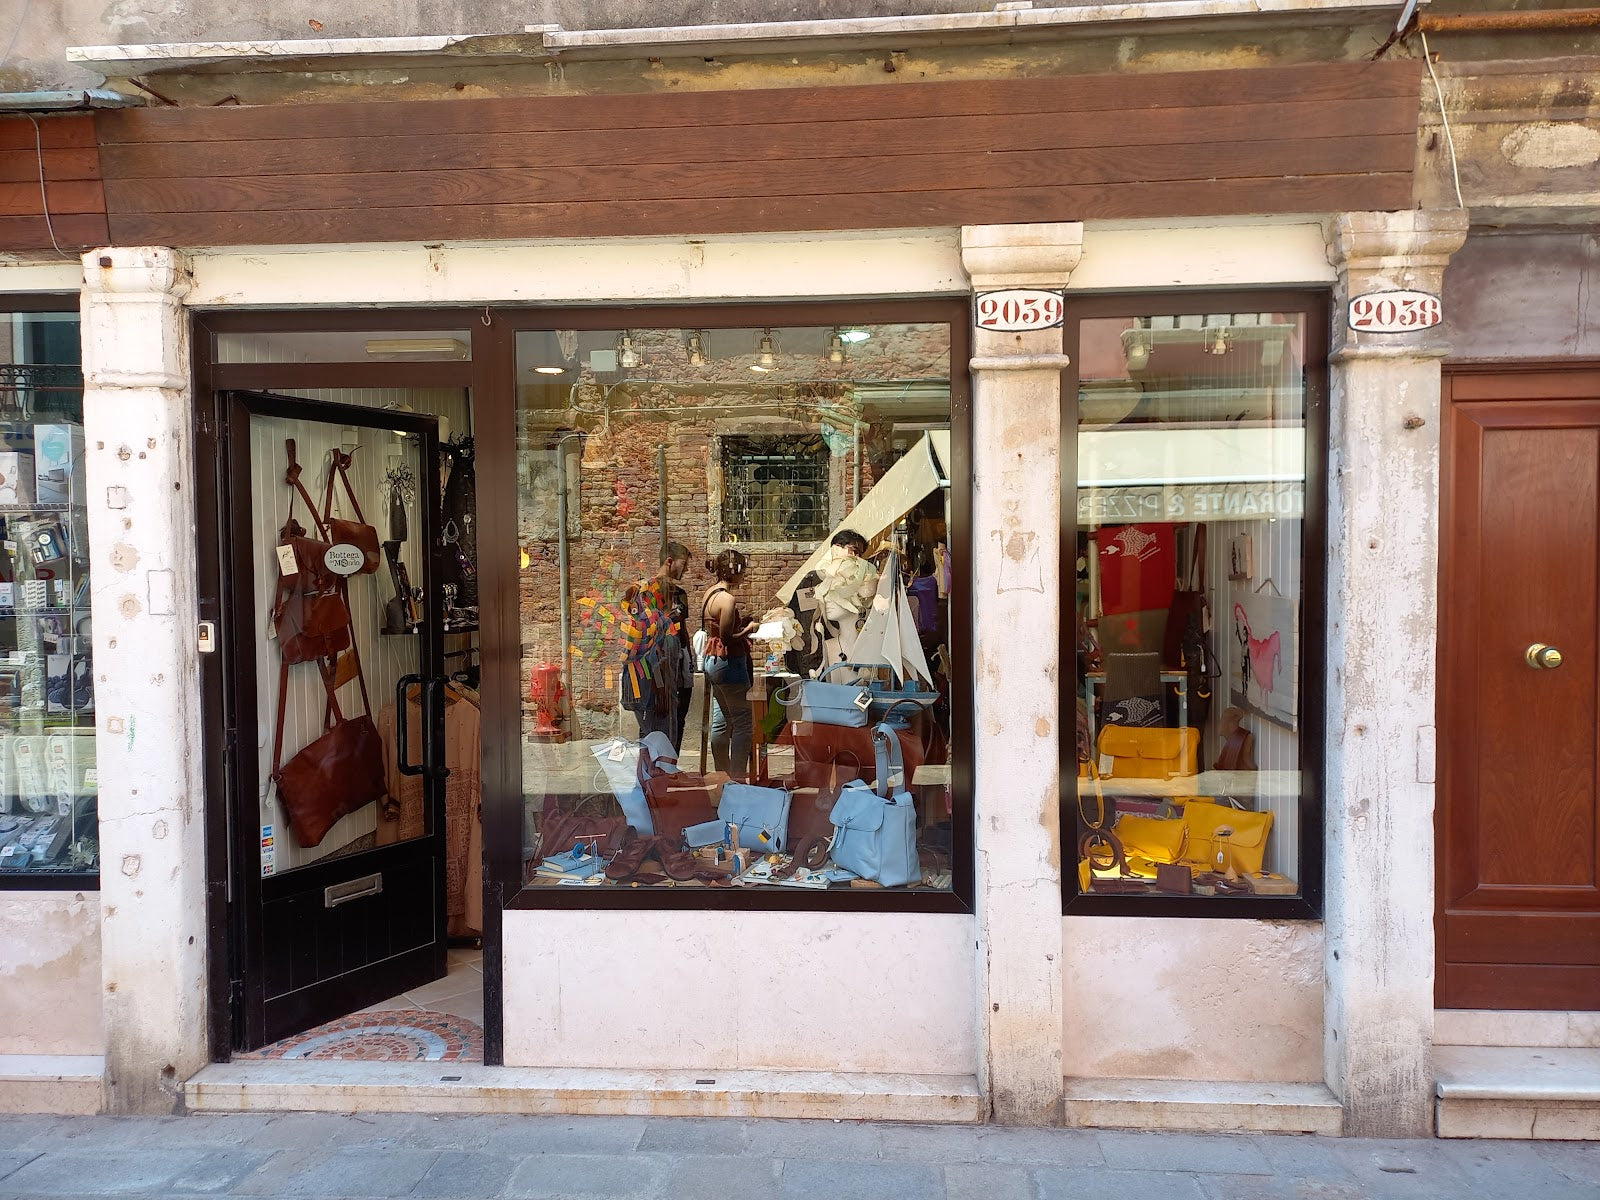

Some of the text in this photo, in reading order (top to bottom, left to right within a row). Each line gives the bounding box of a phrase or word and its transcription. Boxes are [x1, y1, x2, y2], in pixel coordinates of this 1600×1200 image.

[980, 298, 1063, 325] 2039
[1354, 299, 1440, 326] 2038
[329, 552, 360, 560] Bottega
